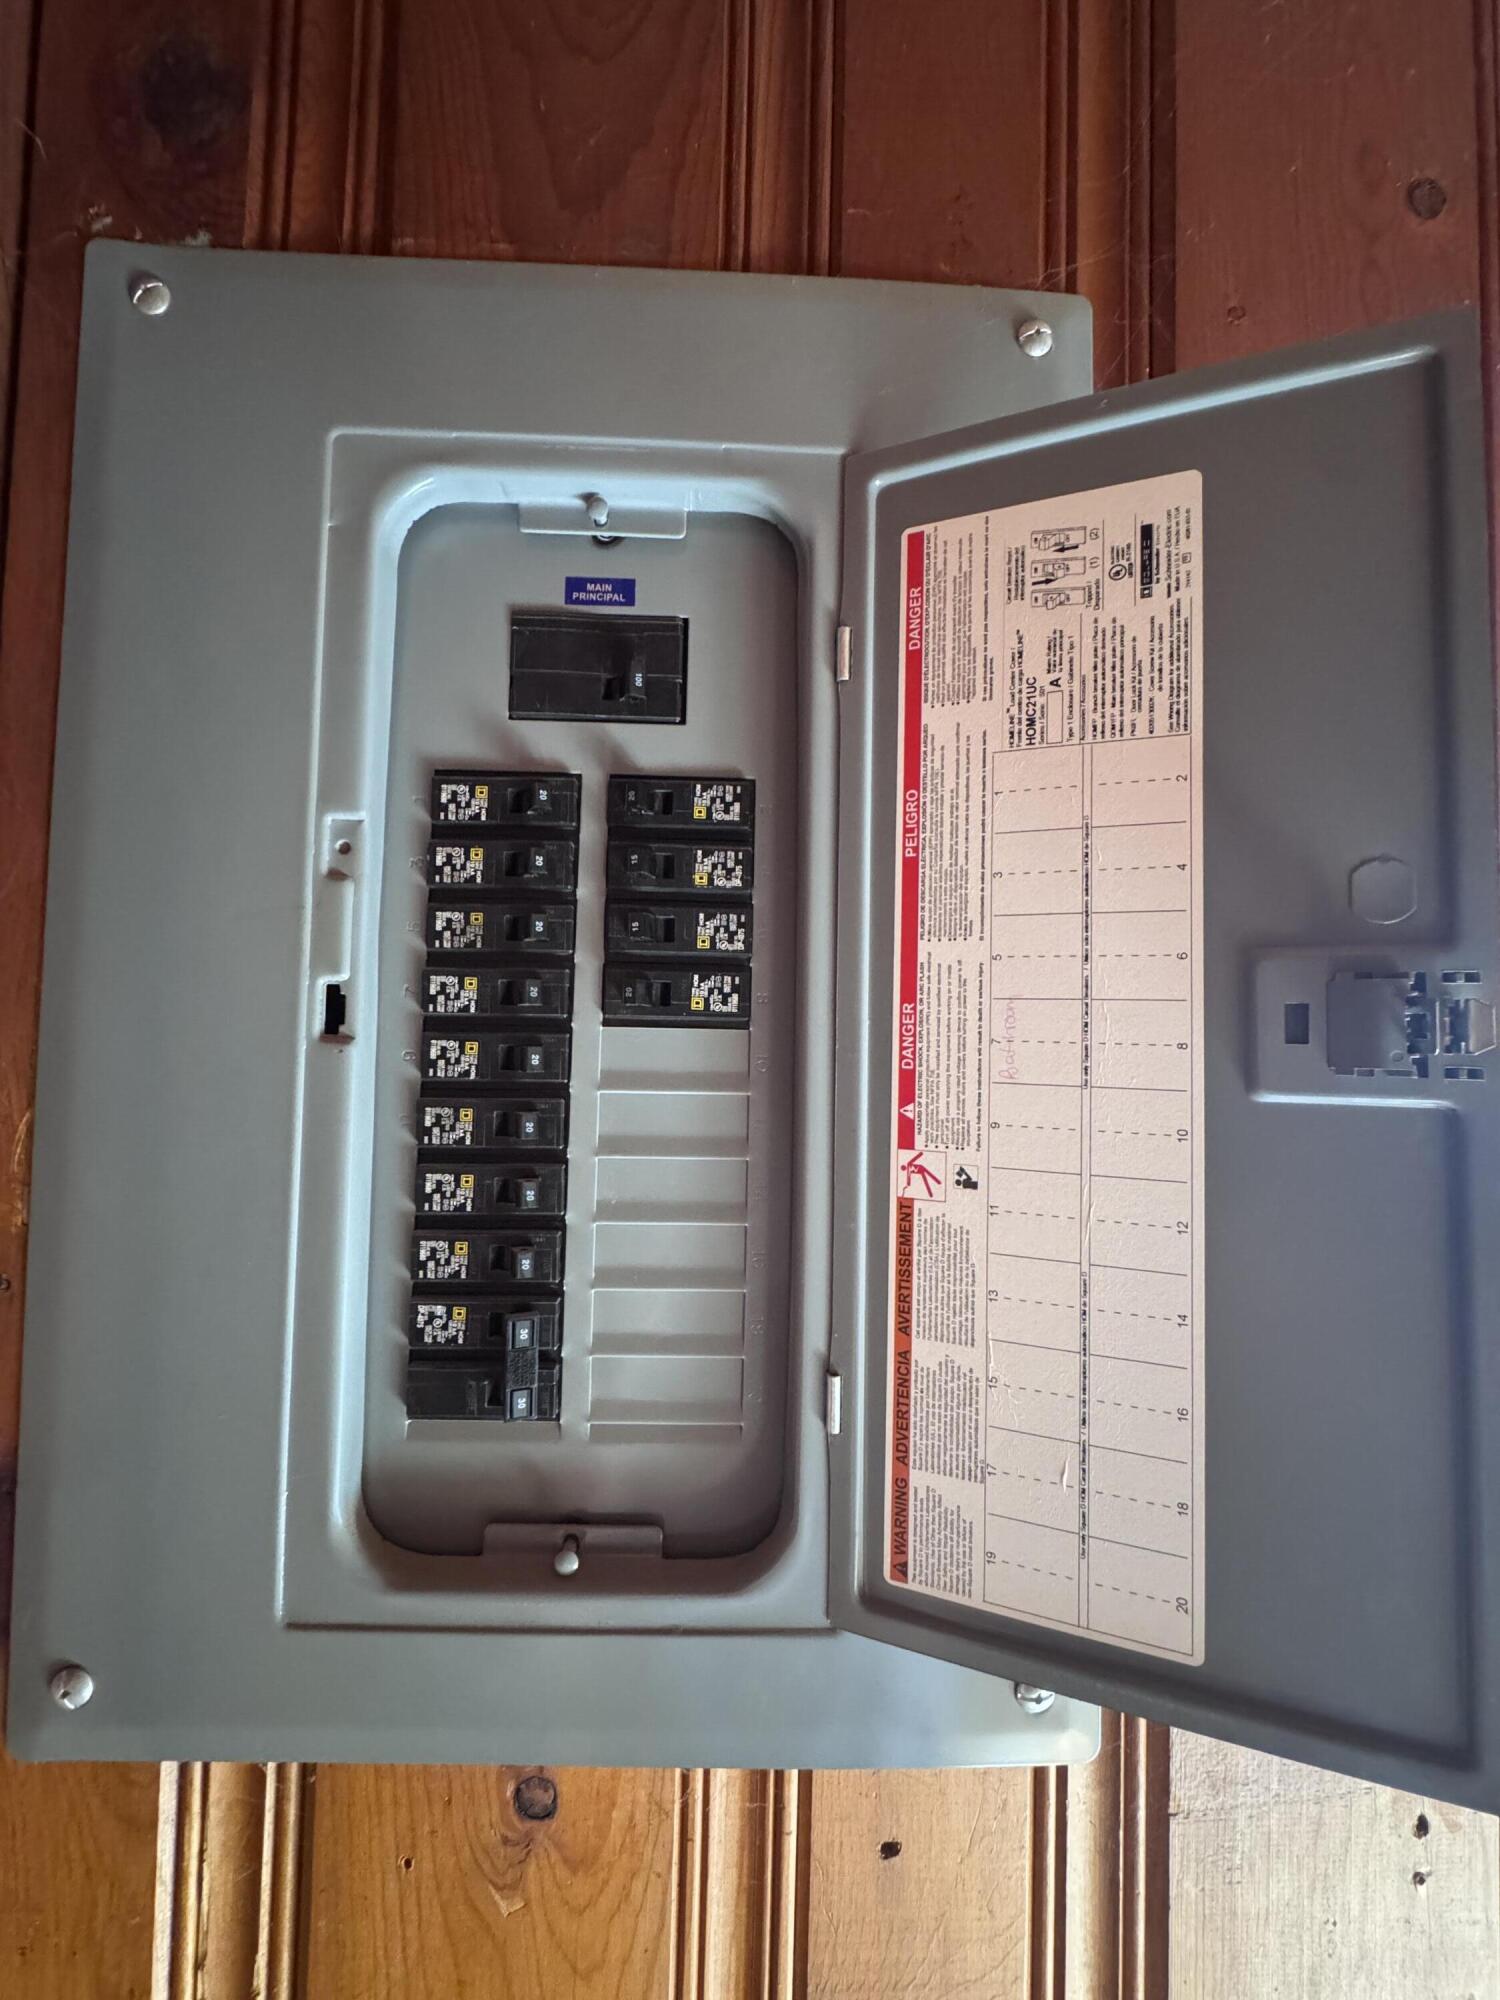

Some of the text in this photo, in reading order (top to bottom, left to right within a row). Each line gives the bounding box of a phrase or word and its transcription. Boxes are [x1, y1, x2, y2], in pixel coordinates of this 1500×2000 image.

[1090, 528, 1100, 540] (2)
[1090, 557, 1100, 568] (1)
[586, 582, 612, 592] MAIN
[572, 592, 626, 602] PRINCIPAL
[908, 586, 922, 650] DANGER
[634, 672, 642, 687] 100
[1050, 677, 1061, 688] A
[1026, 676, 1036, 746] HOMC21UC
[1176, 774, 1187, 782] 2
[539, 790, 548, 800] 20
[628, 790, 635, 800] 20
[905, 789, 918, 857] PELIGRO
[535, 856, 543, 866] 20
[631, 854, 638, 864] 15
[992, 871, 1003, 879] 3
[535, 921, 544, 932] 20
[632, 922, 639, 931] 15
[1176, 952, 1188, 960] 6
[530, 986, 538, 998] 20
[626, 987, 632, 998] 20
[901, 1003, 915, 1070] DANGER
[1177, 1042, 1188, 1050] 8
[531, 1054, 539, 1065] 20
[526, 1122, 534, 1133] 20
[1177, 1129, 1188, 1143] 10
[526, 1190, 534, 1201] 20
[990, 1205, 999, 1216] 11
[1177, 1221, 1188, 1236] 12
[521, 1259, 530, 1270] 20
[988, 1289, 998, 1303] 13
[1177, 1314, 1188, 1329] 14
[520, 1328, 528, 1340] 30
[894, 1202, 912, 1556] WARNING ADVERTENCIA AVERTISSEMENT
[988, 1376, 998, 1390] 15
[517, 1398, 526, 1409] 30
[1177, 1408, 1188, 1423] 16
[987, 1463, 997, 1477] 17
[1177, 1502, 1188, 1517] 18
[986, 1552, 996, 1564] 19
[1176, 1597, 1188, 1614] 20
